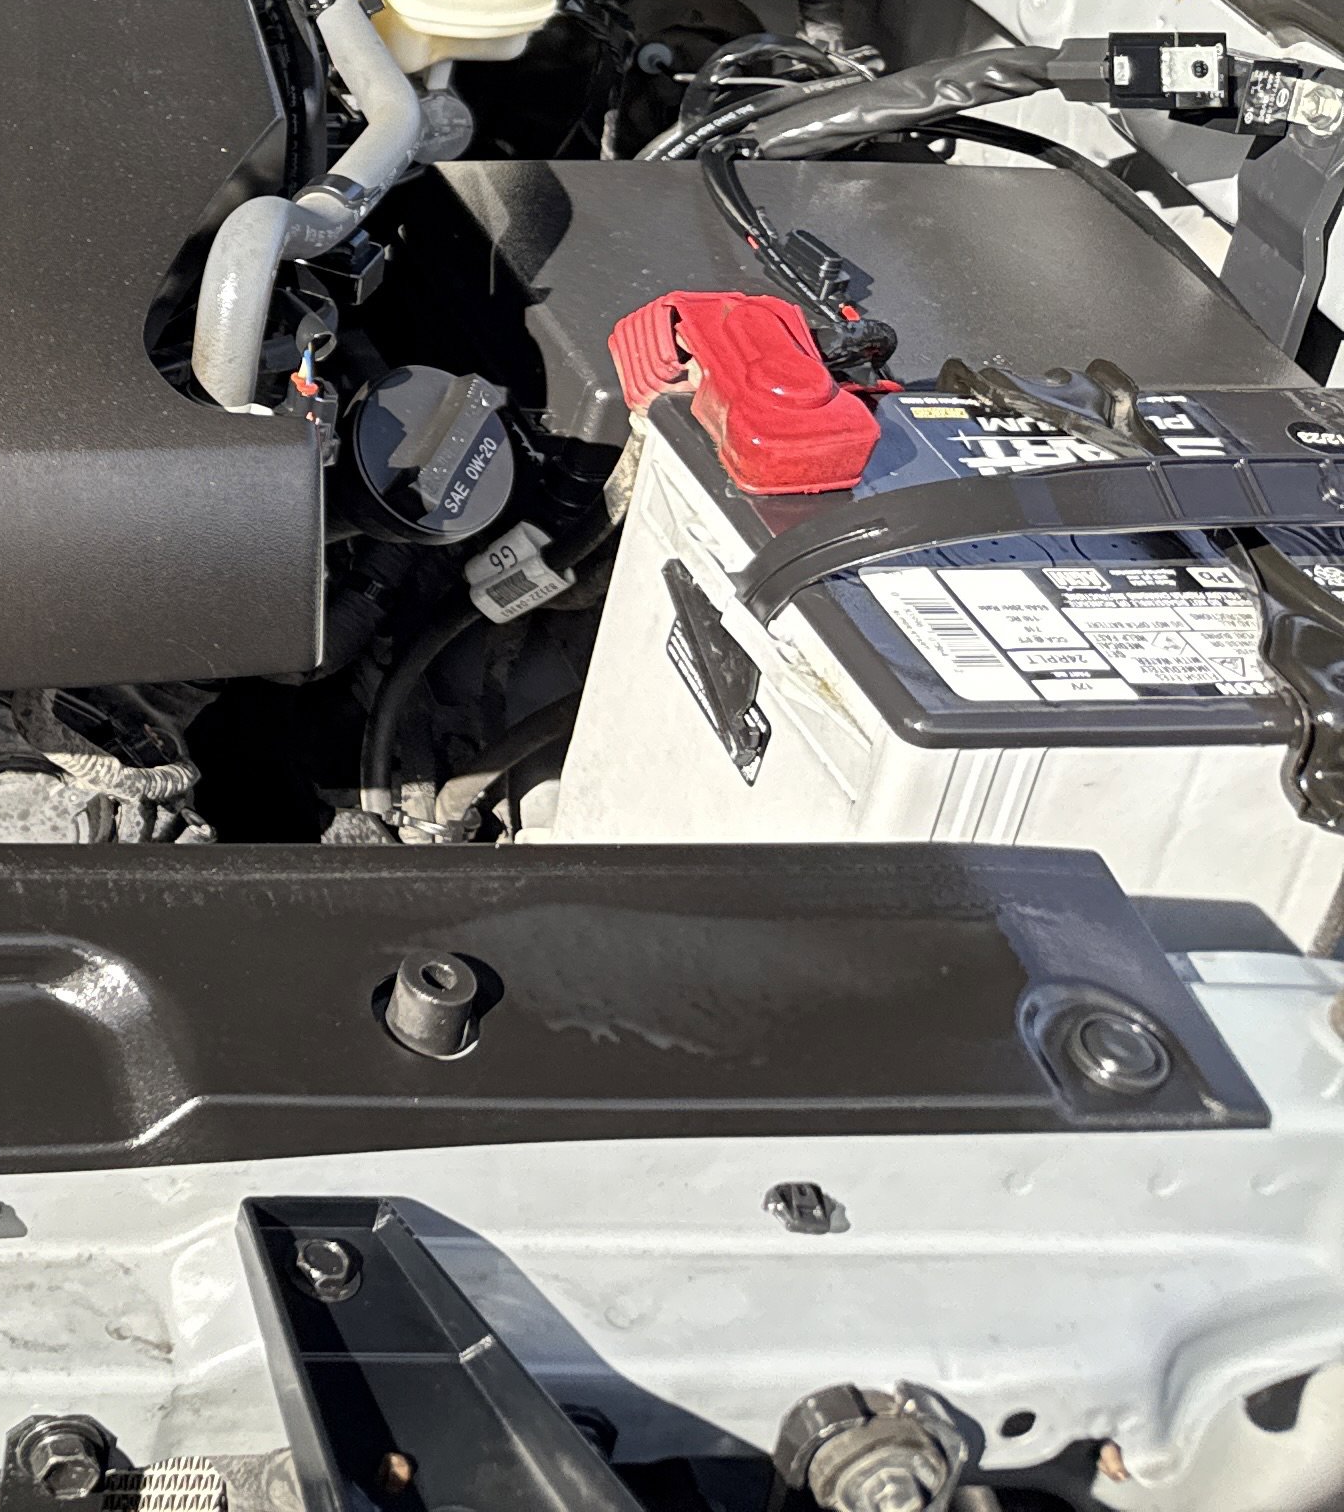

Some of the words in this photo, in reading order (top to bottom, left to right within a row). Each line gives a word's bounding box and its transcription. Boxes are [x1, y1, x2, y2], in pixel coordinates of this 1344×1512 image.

[444, 481, 470, 514] SAE
[465, 436, 498, 481] 0W-20
[489, 544, 518, 575] G6
[1198, 571, 1234, 584] Pb
[1096, 642, 1145, 650] MEDICAL
[1025, 654, 1088, 665] 24RPLT
[1139, 665, 1210, 673] IMMEDIATELY
[1154, 673, 1182, 681] EYES
[1187, 673, 1219, 681] FLUSH
